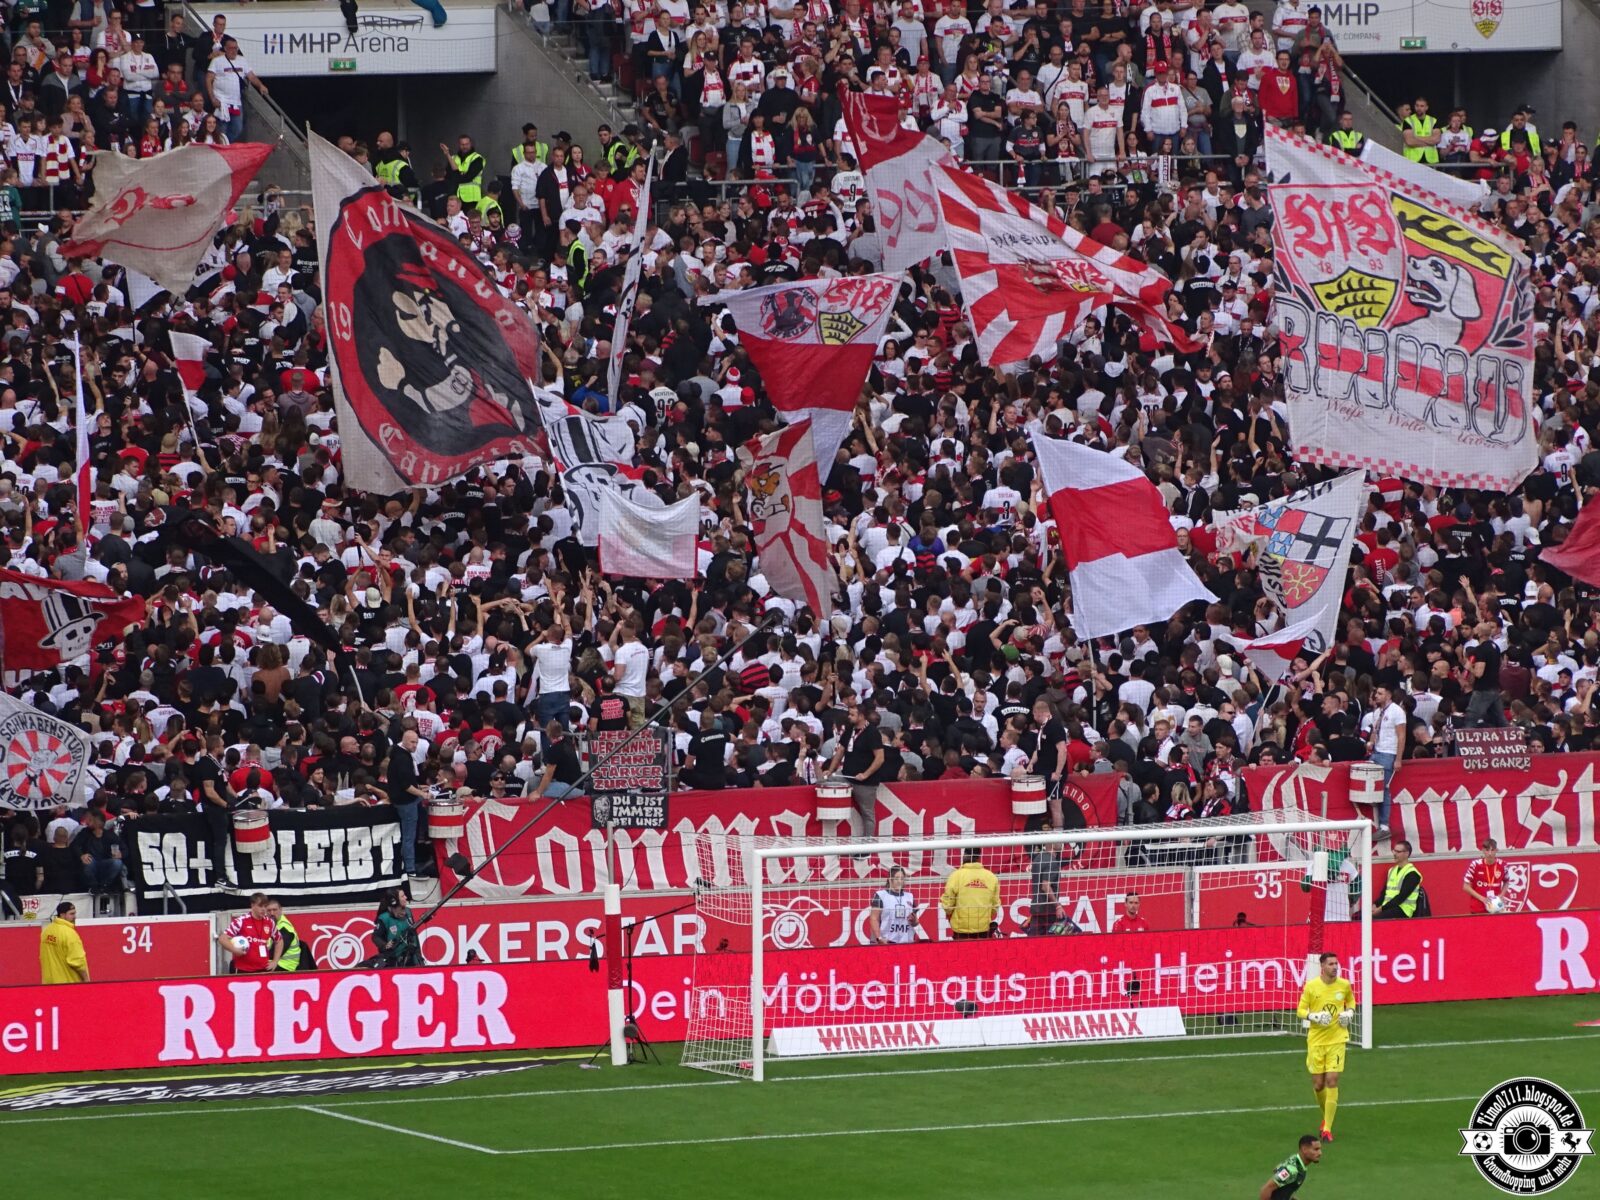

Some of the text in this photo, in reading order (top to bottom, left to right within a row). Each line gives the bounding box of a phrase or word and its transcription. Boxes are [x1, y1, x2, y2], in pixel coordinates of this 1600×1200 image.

[1323, 3, 1379, 25] MHP
[289, 33, 409, 53] MHP Arena
[1317, 258, 1384, 275] 18 93
[329, 301, 351, 342] 19
[1456, 731, 1500, 743] ULTRA
[1459, 744, 1528, 756] DER KAMPF
[1463, 756, 1531, 770] UMS GANZE
[612, 796, 664, 806] DU BIST
[612, 807, 664, 818] IMMER
[636, 817, 664, 827] UNS!
[250, 822, 402, 884] BLEIBT
[1254, 872, 1283, 899] 35
[122, 924, 153, 953] 34
[1535, 916, 1597, 992] R
[753, 965, 1028, 1015] Möbelhaus
[1050, 955, 1134, 1000] mit
[1154, 938, 1446, 999] Heimvrteil
[157, 970, 517, 1062] RIEGER
[1022, 1011, 1144, 1042] WINAMAX
[818, 1021, 941, 1053] WINAMAX
